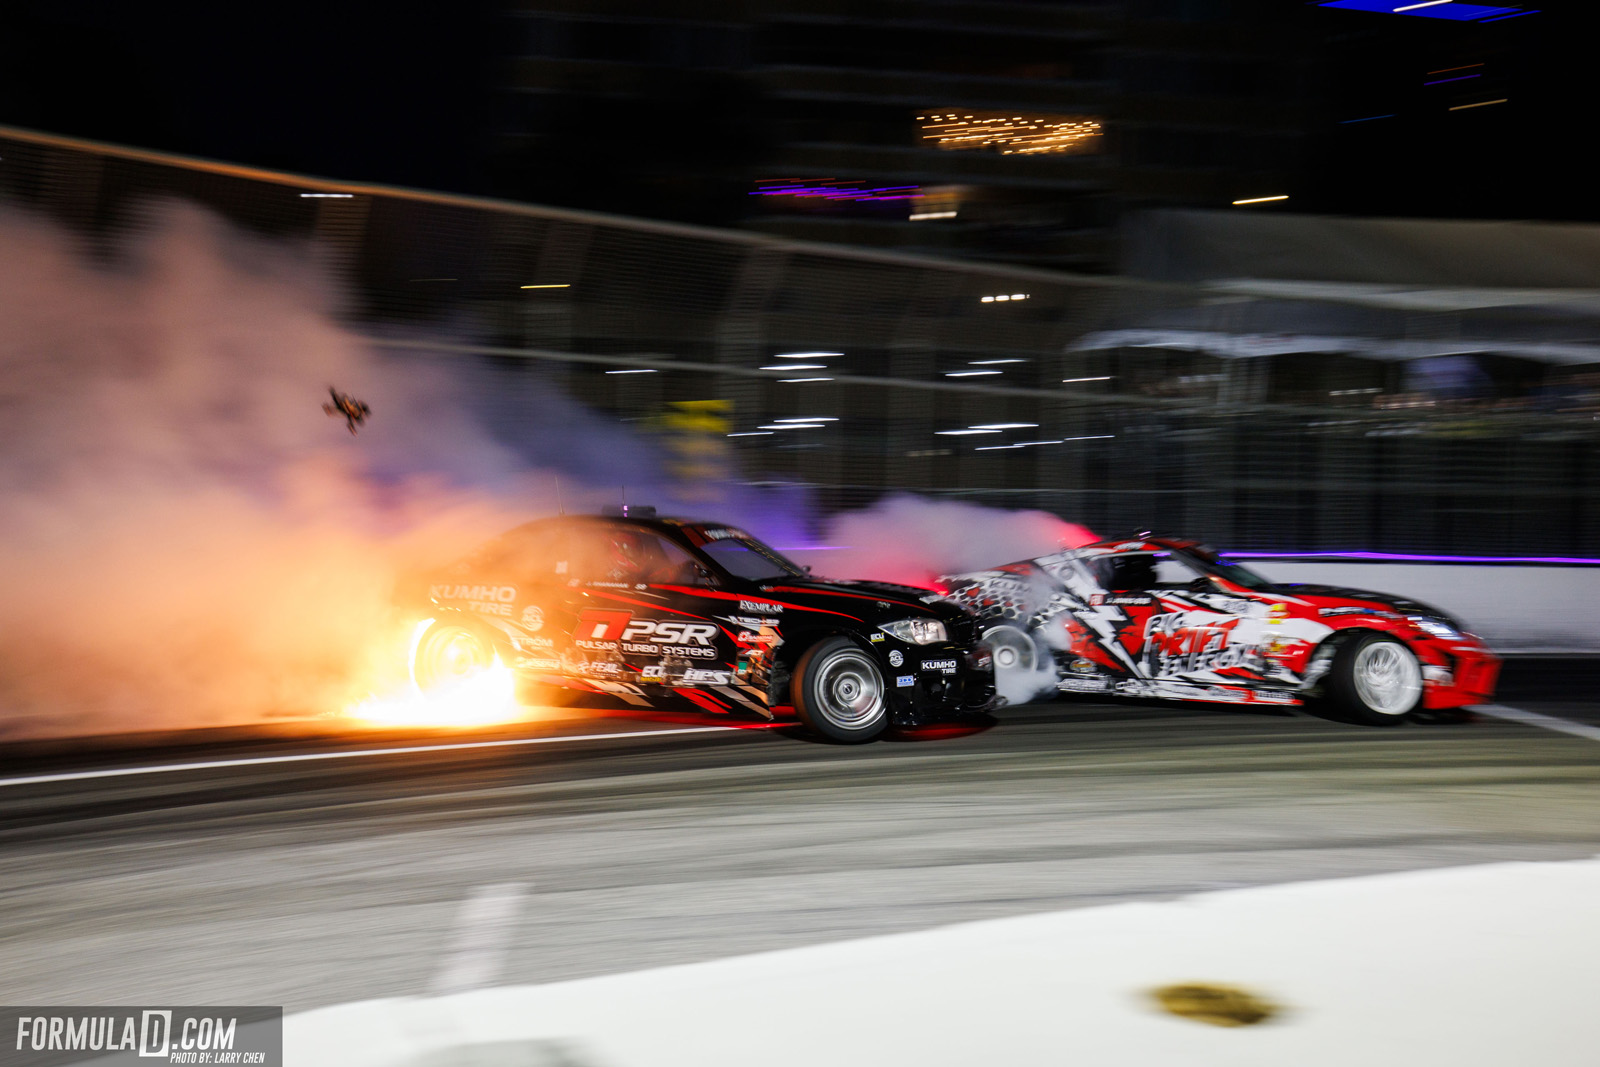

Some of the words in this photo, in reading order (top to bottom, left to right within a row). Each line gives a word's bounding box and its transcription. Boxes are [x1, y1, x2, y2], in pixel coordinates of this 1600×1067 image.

[430, 585, 516, 602] KUMHO
[468, 601, 513, 616] TIRE
[740, 600, 783, 613] EXEMPLAR
[621, 621, 717, 645] PSR
[576, 640, 618, 650] PULSAR
[621, 643, 659, 653] TURBO
[662, 646, 715, 657] SYSTEMS
[922, 660, 957, 669] KUMHO
[683, 669, 732, 684] HPS
